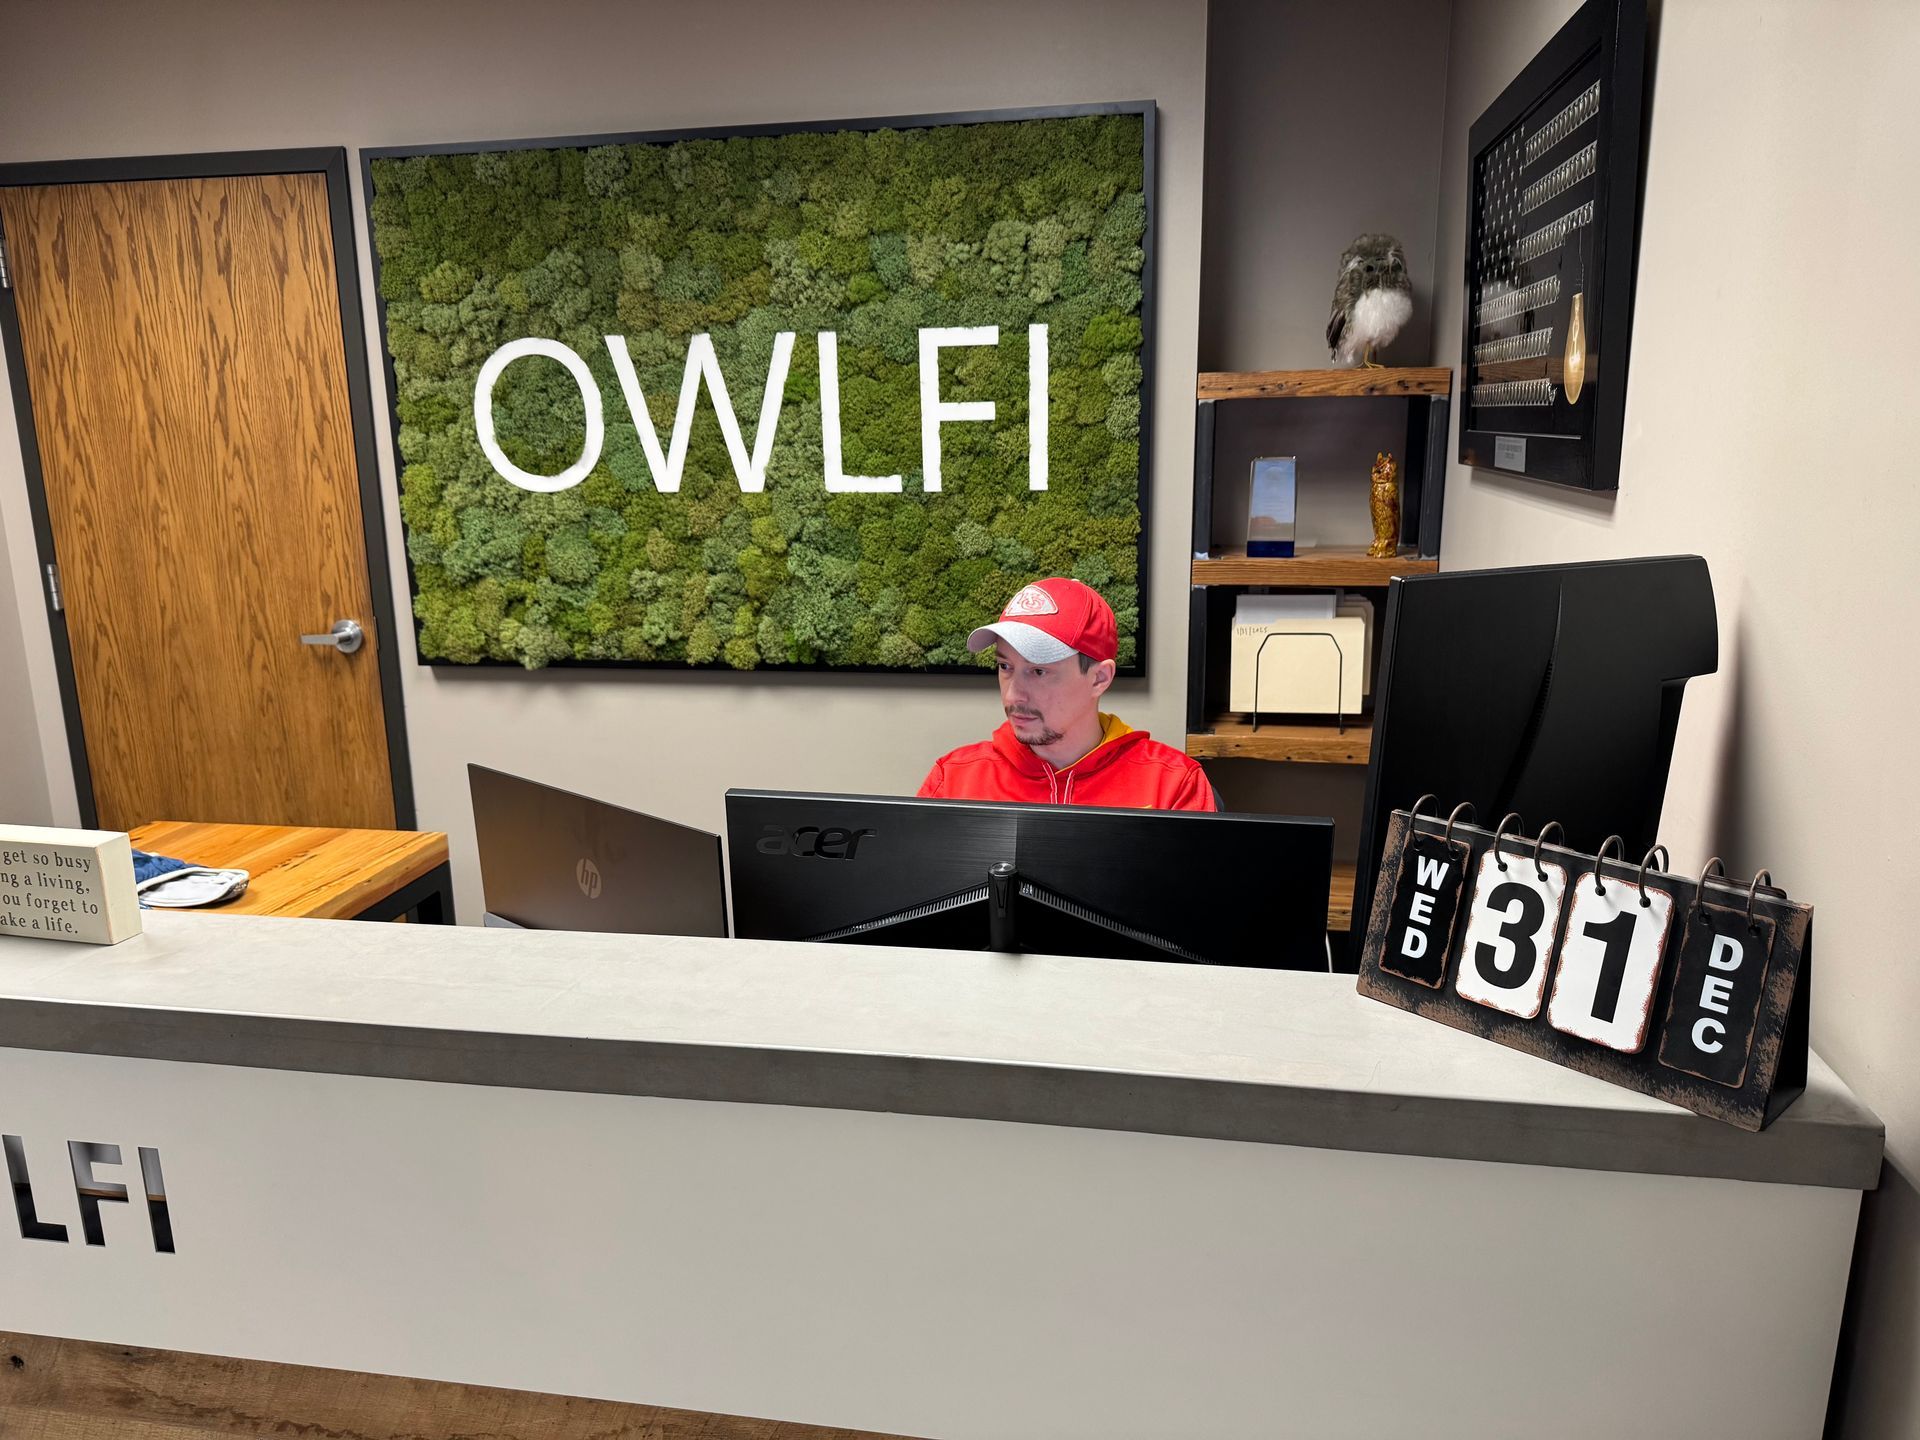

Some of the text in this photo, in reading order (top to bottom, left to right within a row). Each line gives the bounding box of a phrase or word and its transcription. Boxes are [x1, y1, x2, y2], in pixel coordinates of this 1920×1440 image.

[474, 324, 1049, 493] OWLFI
[756, 825, 878, 861] acer
[3, 850, 91, 873] get so busy
[579, 858, 600, 898] hp
[24, 874, 33, 886] a
[36, 871, 90, 895] living,
[26, 892, 77, 914] forget
[82, 899, 98, 915] to
[1400, 855, 1450, 960] WED
[32, 918, 40, 930] a
[45, 915, 78, 934] life.
[1691, 934, 1745, 1055] DEC
